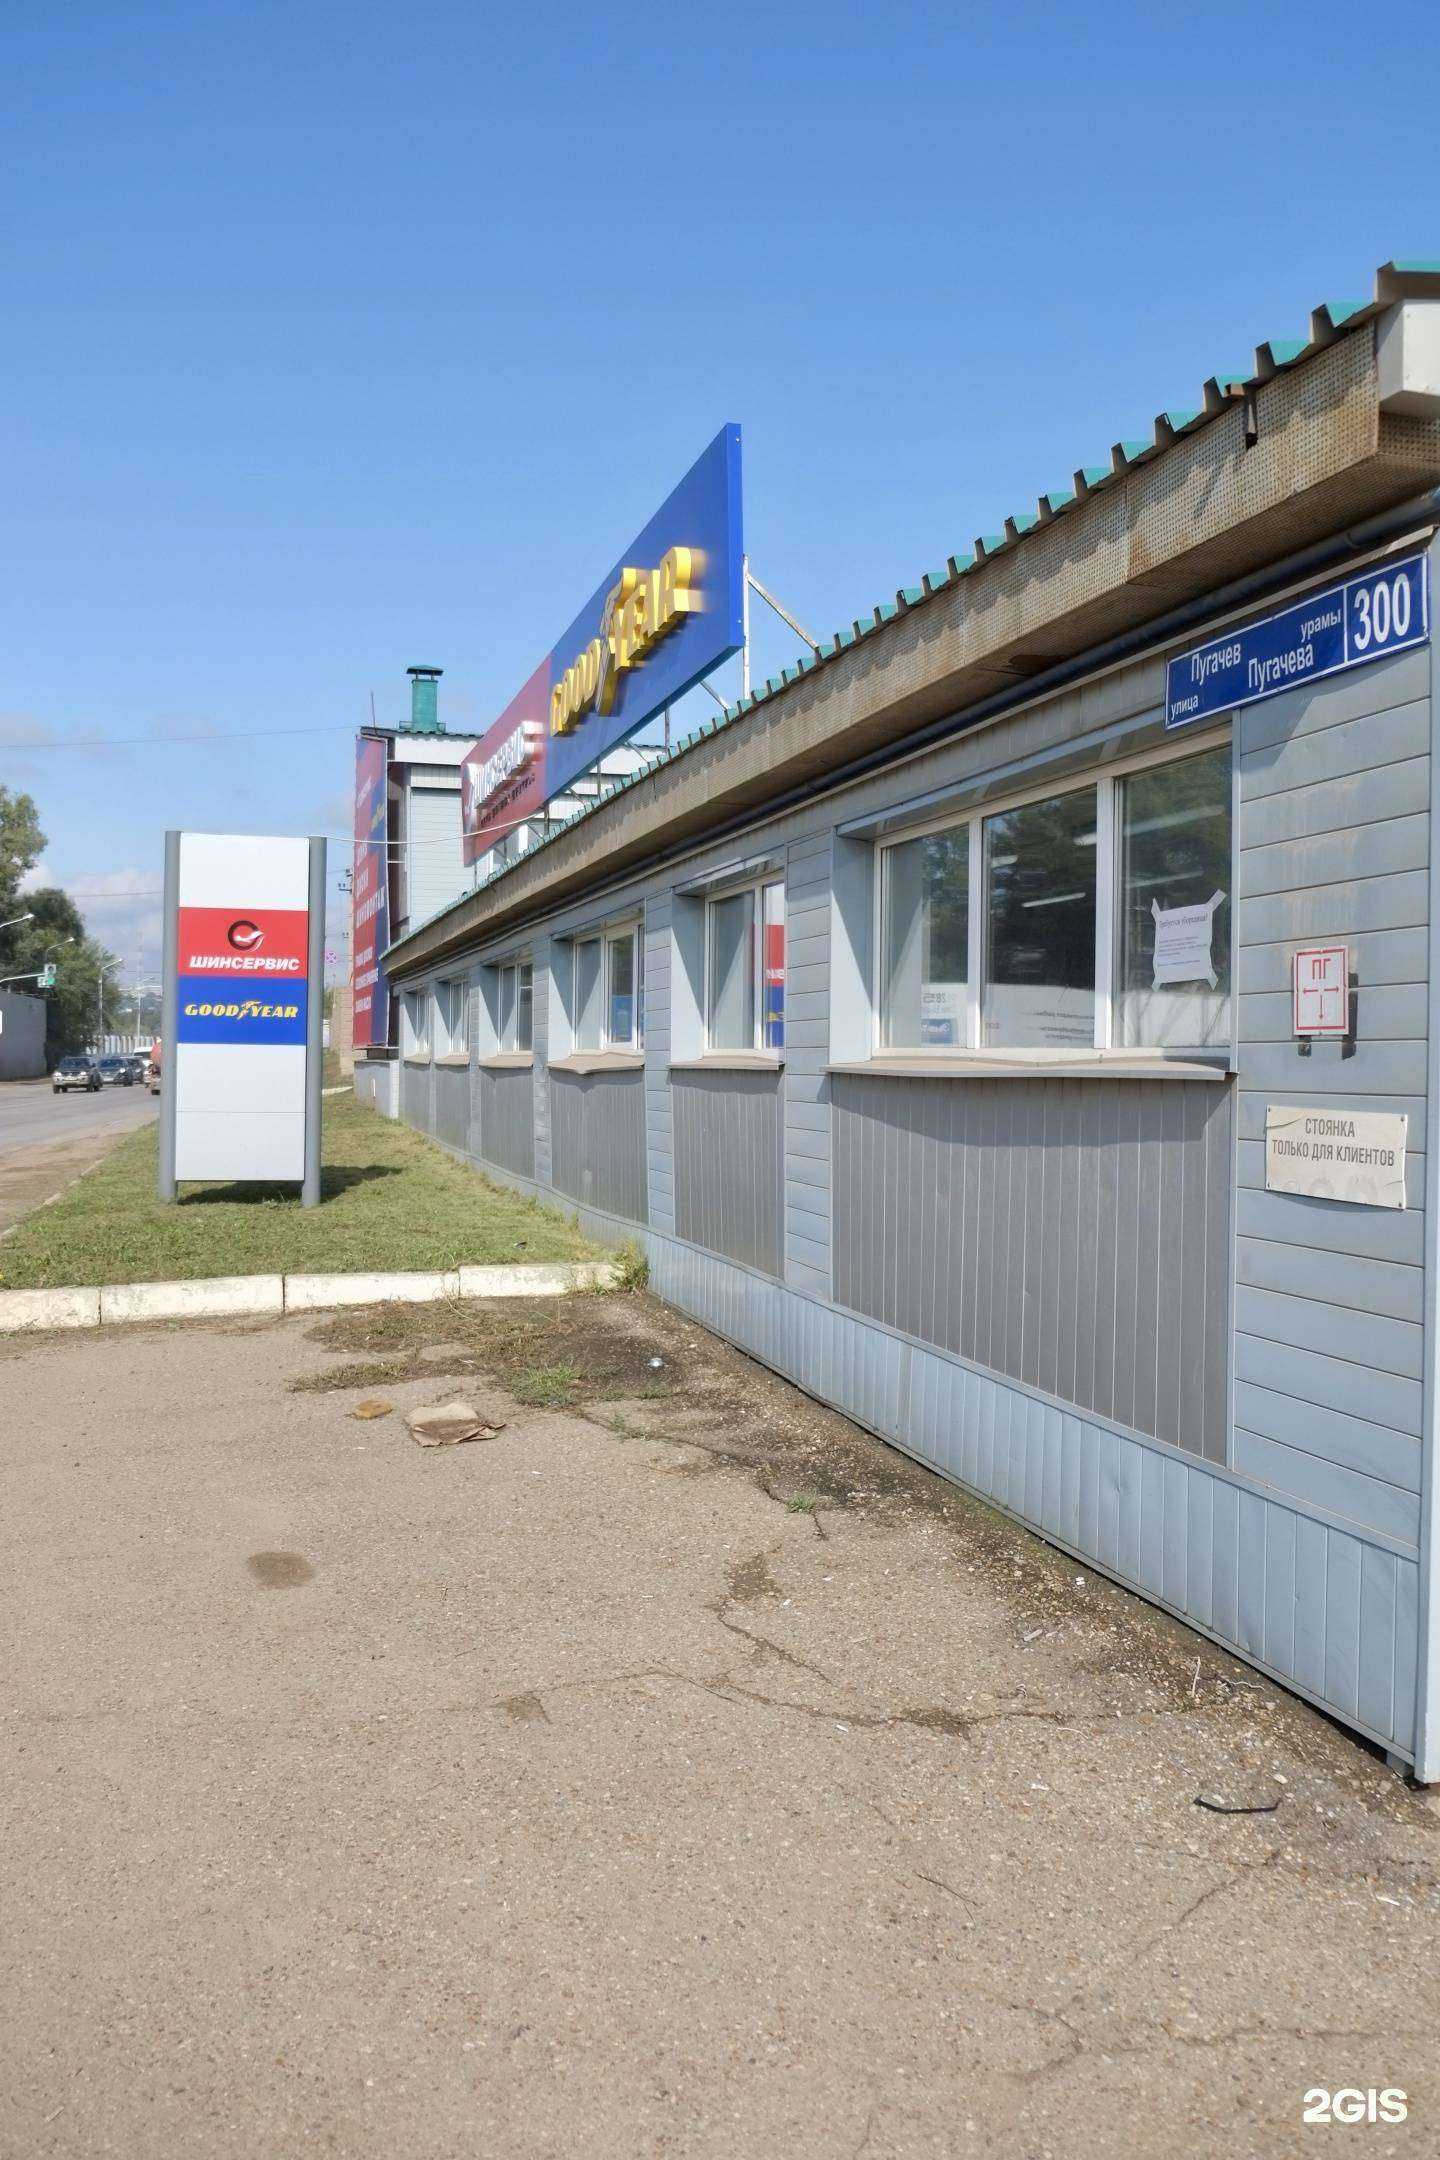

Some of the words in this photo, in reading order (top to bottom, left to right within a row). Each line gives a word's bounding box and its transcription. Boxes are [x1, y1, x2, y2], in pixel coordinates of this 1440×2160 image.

[1353, 573, 1411, 650] 300
[1191, 643, 1241, 686] Пугачев
[1300, 608, 1342, 643] урамы
[1170, 694, 1199, 720] улица
[1248, 643, 1314, 692] Пугачева
[189, 955, 300, 971] ШИНСЕРВИС
[1311, 958, 1332, 980] ПГ
[1305, 1117, 1355, 1138] СТОЯНКА
[1272, 1139, 1309, 1158] ТОЛЬКО
[1312, 1143, 1334, 1162] ДЛЯ
[1336, 1145, 1395, 1167] КЛИЕНТОВ
